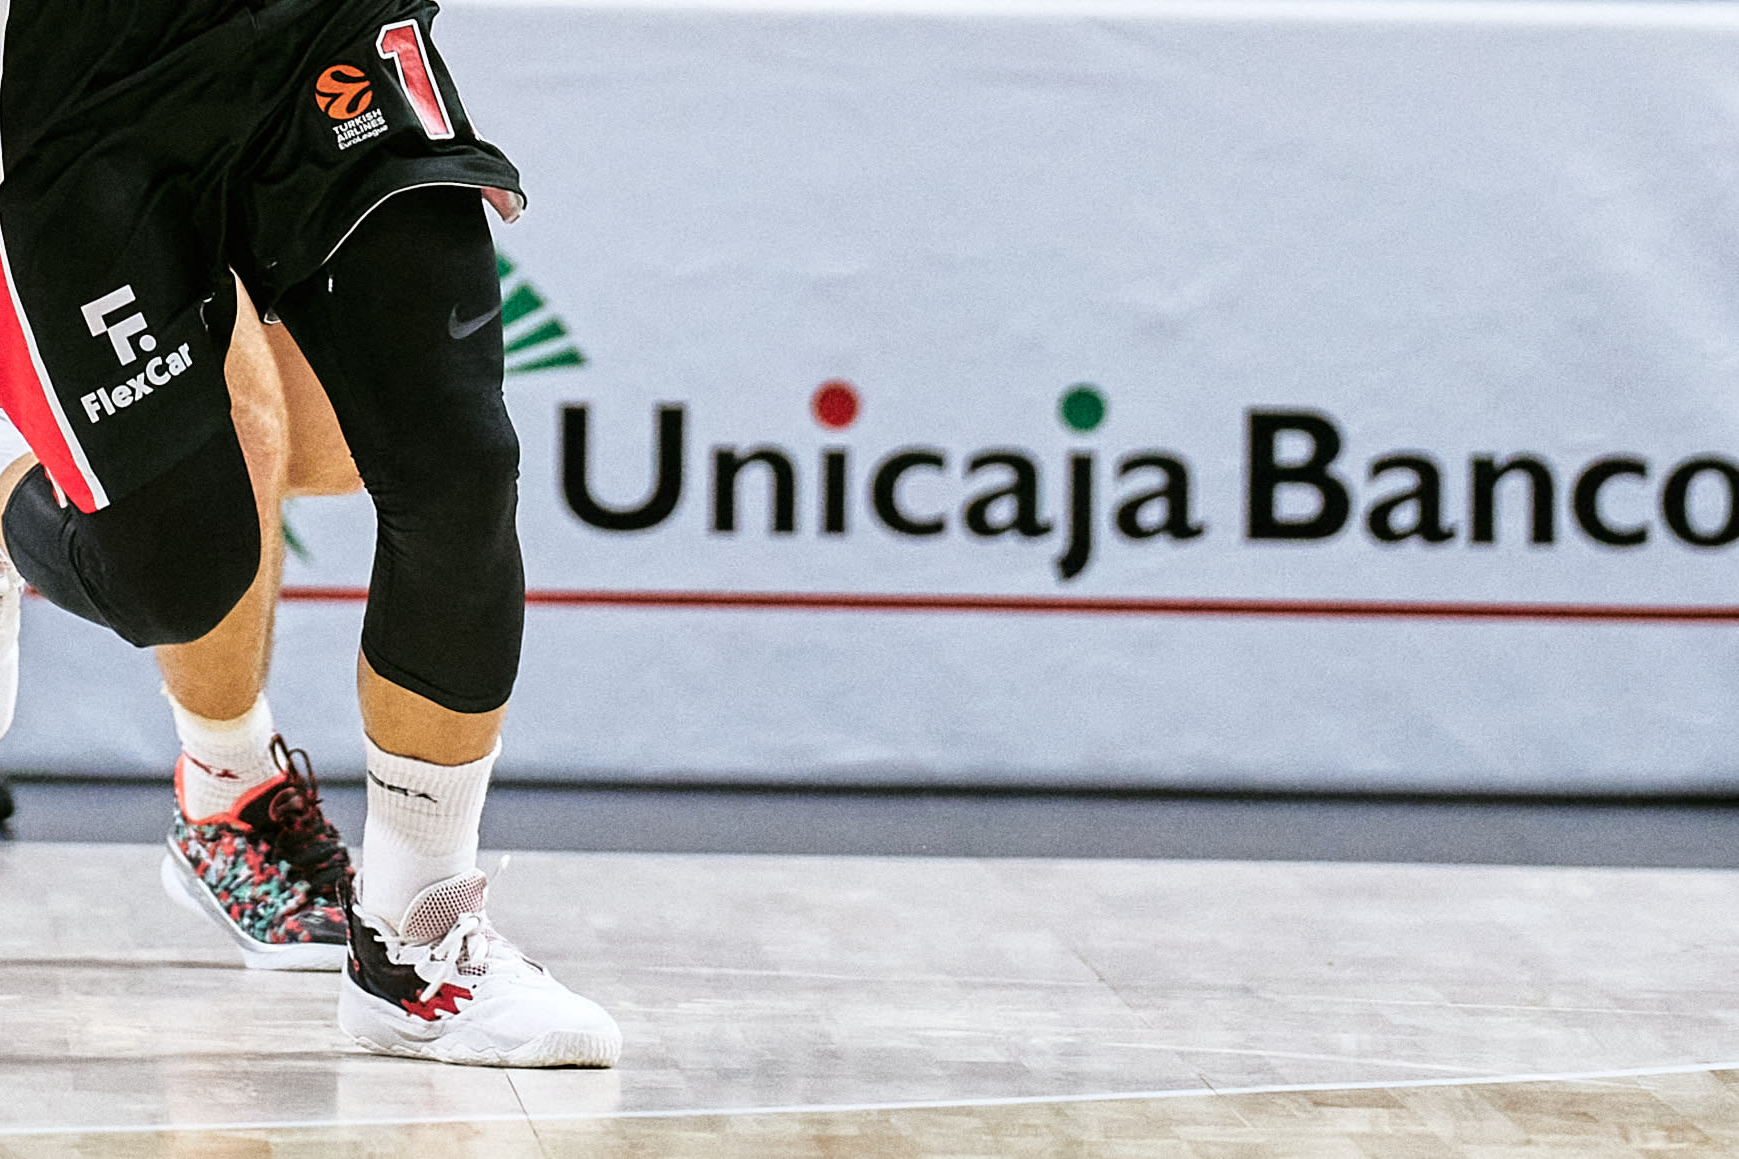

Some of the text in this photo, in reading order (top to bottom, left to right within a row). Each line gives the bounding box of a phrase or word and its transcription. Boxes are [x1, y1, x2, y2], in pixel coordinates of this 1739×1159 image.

[332, 108, 382, 134] TURKISH
[337, 116, 386, 143] AIRLINES
[80, 342, 193, 424] FlexCar
[560, 378, 1739, 583] Unicaja Banco
